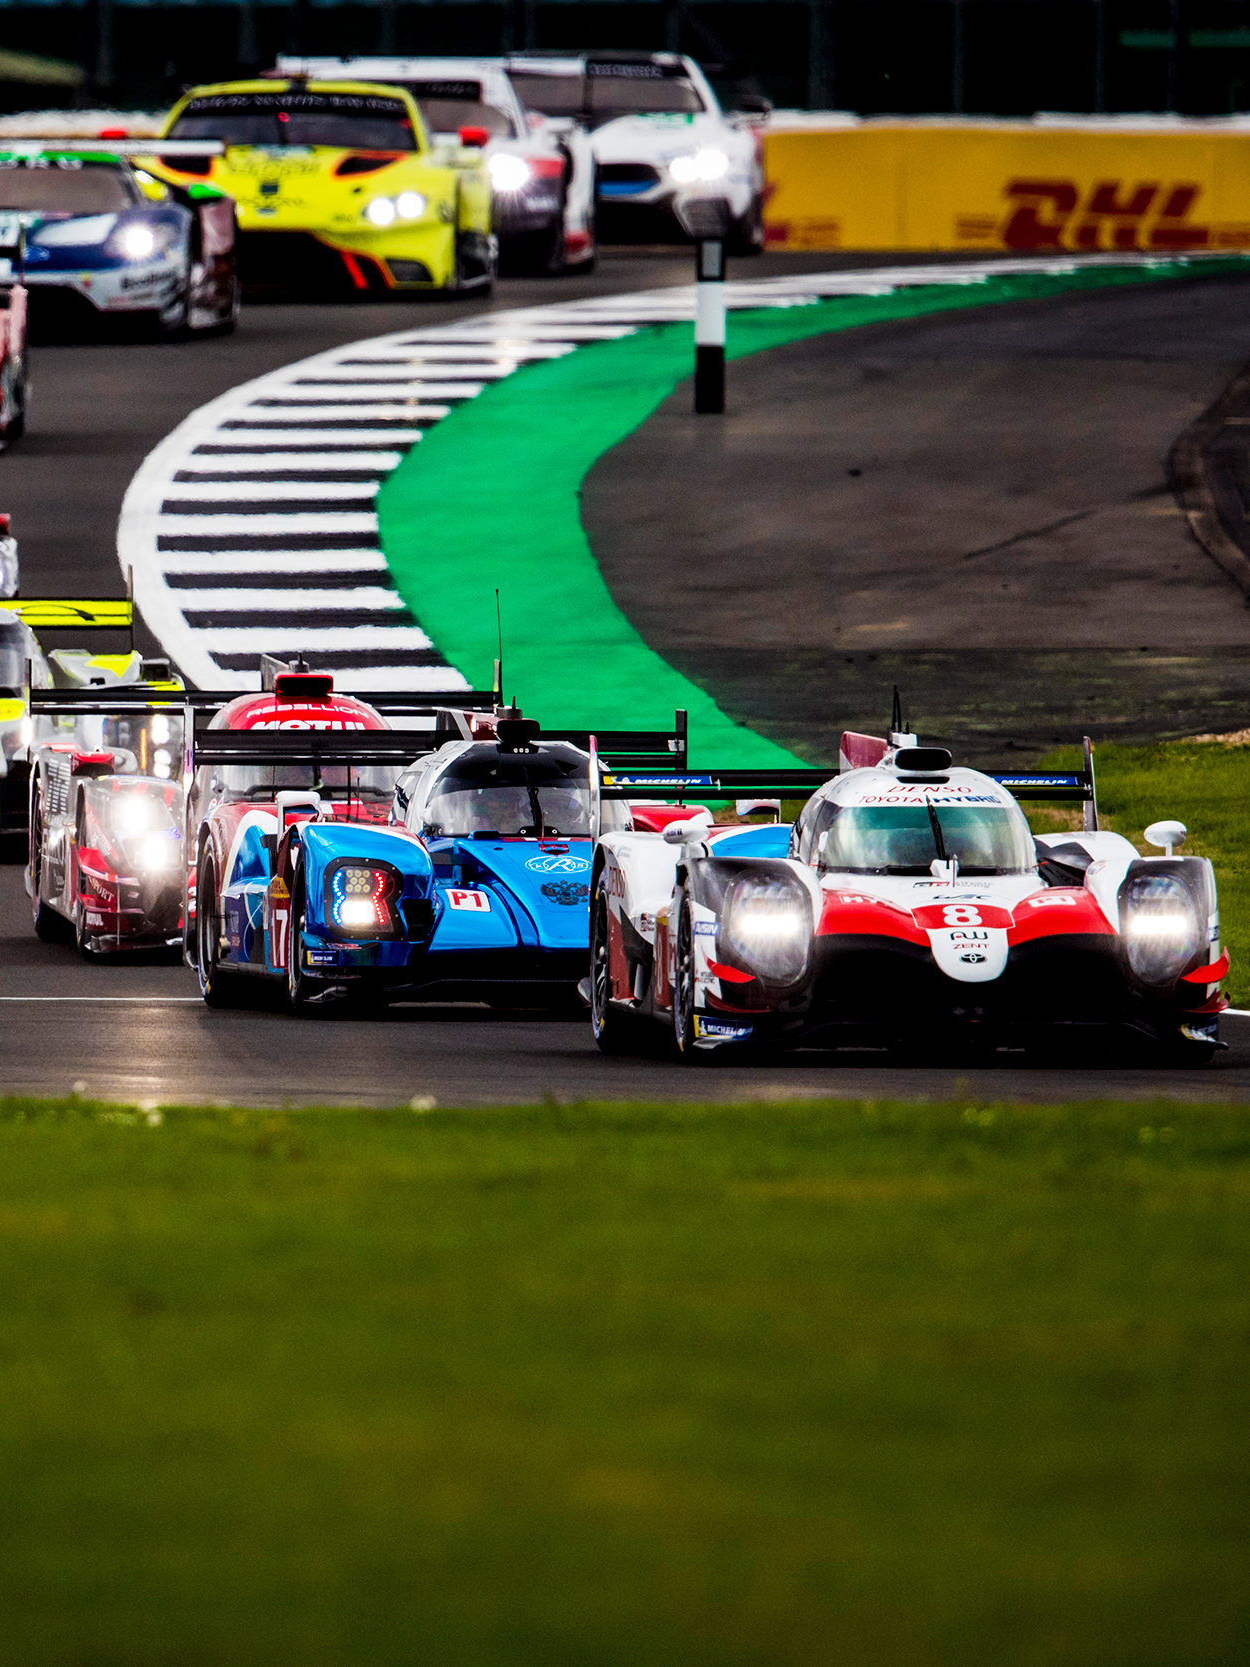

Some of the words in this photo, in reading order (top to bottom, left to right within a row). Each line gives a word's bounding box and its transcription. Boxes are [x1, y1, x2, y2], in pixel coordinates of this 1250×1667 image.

[1004, 178, 1209, 248] DHL
[246, 703, 370, 718] REBELLION
[887, 785, 972, 793] DENSO
[857, 795, 923, 804] TOYOTA
[451, 891, 483, 908] P1
[942, 904, 983, 927] 8
